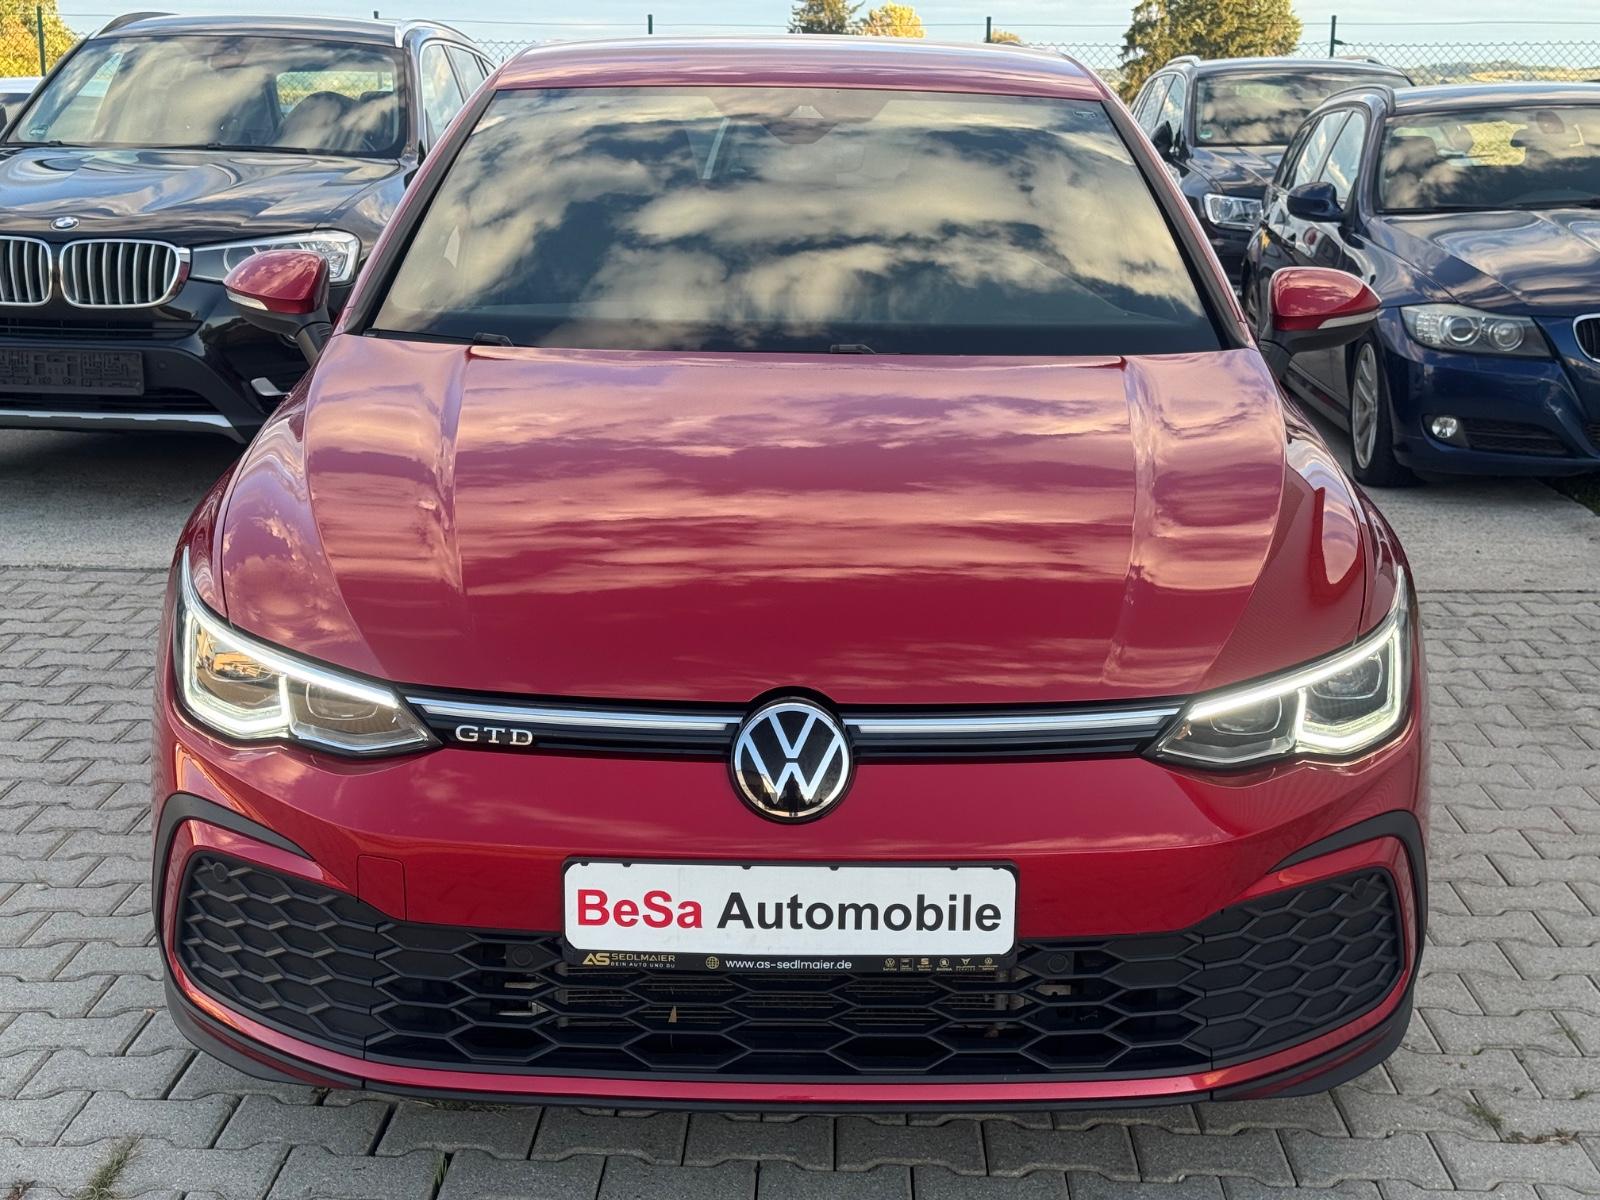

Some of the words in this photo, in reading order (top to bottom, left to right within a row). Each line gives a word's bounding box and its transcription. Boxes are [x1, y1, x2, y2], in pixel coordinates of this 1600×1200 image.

[455, 724, 533, 746] GTD
[577, 888, 703, 929] BeSa
[716, 892, 1002, 931] Automobile
[582, 952, 610, 966] AS
[610, 953, 676, 962] SEDLMAIER
[725, 958, 852, 970] www.as-sedlmaier.de
